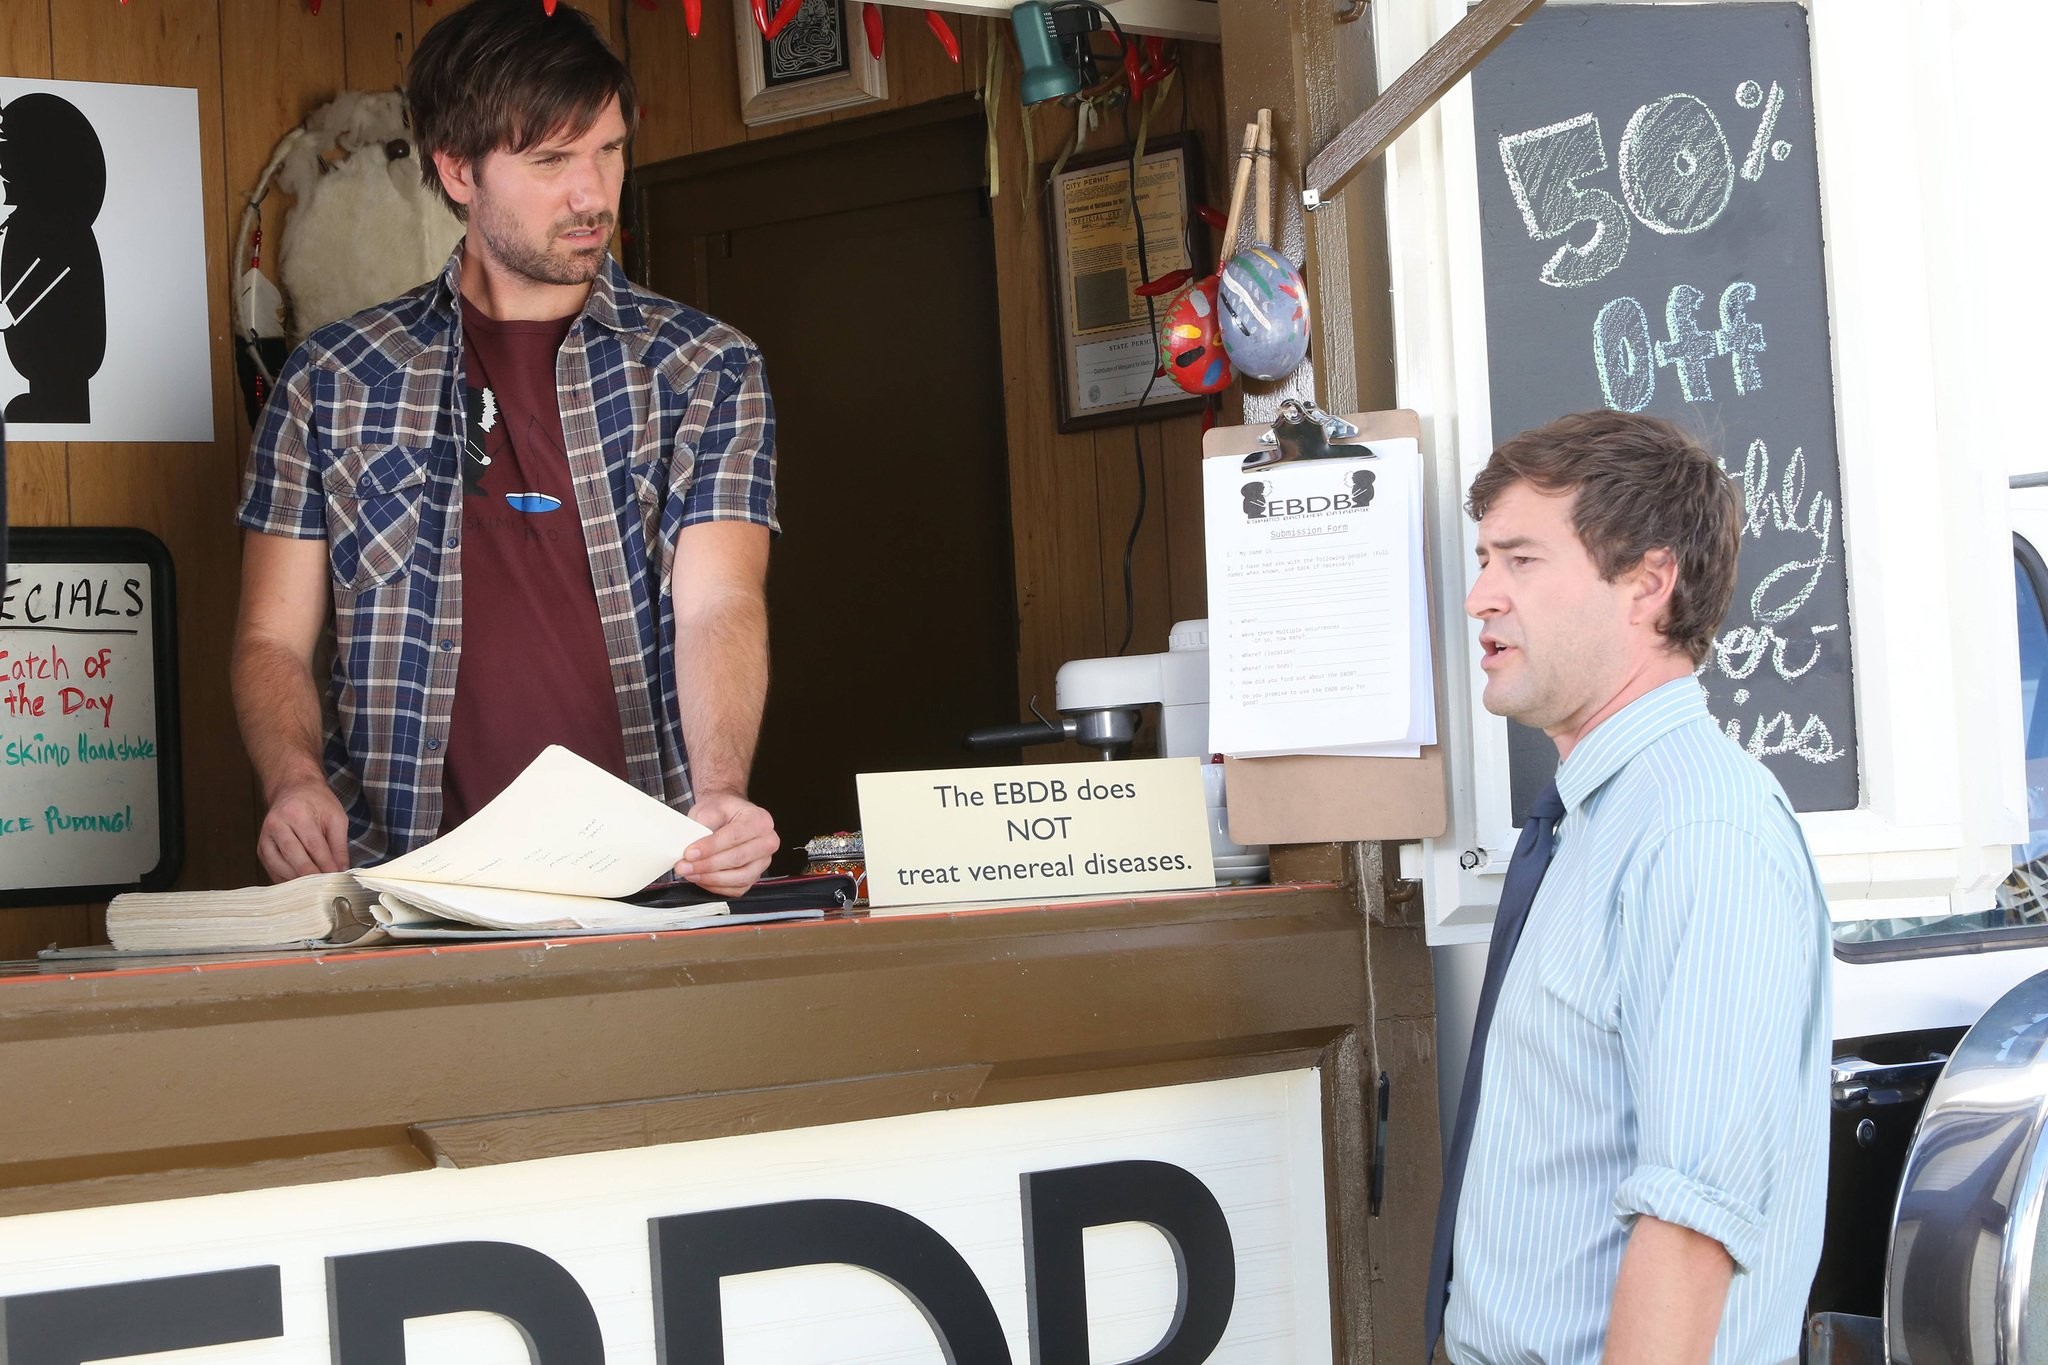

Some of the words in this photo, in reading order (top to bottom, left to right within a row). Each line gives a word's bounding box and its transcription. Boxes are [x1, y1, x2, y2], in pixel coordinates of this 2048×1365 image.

[1065, 182, 1081, 190] CITY
[1083, 175, 1110, 185] PERMIT
[1499, 79, 1793, 288] 50%
[1109, 343, 1129, 352] STATE
[1131, 338, 1155, 347] PERMI
[1592, 281, 1768, 413] Off
[1268, 494, 1352, 517] EBDB
[1270, 526, 1322, 539] Submission
[1327, 524, 1349, 533] Form
[84, 648, 112, 679] of
[4, 682, 46, 717] the
[58, 687, 114, 728] Day
[0, 732, 70, 767] skimo
[933, 784, 985, 808] The
[993, 779, 1068, 806] EBDB
[1077, 778, 1137, 801] does
[1006, 816, 1073, 842] NOT
[897, 864, 961, 886] treat
[968, 853, 1075, 882] venereal
[1083, 851, 1193, 876] diseases.
